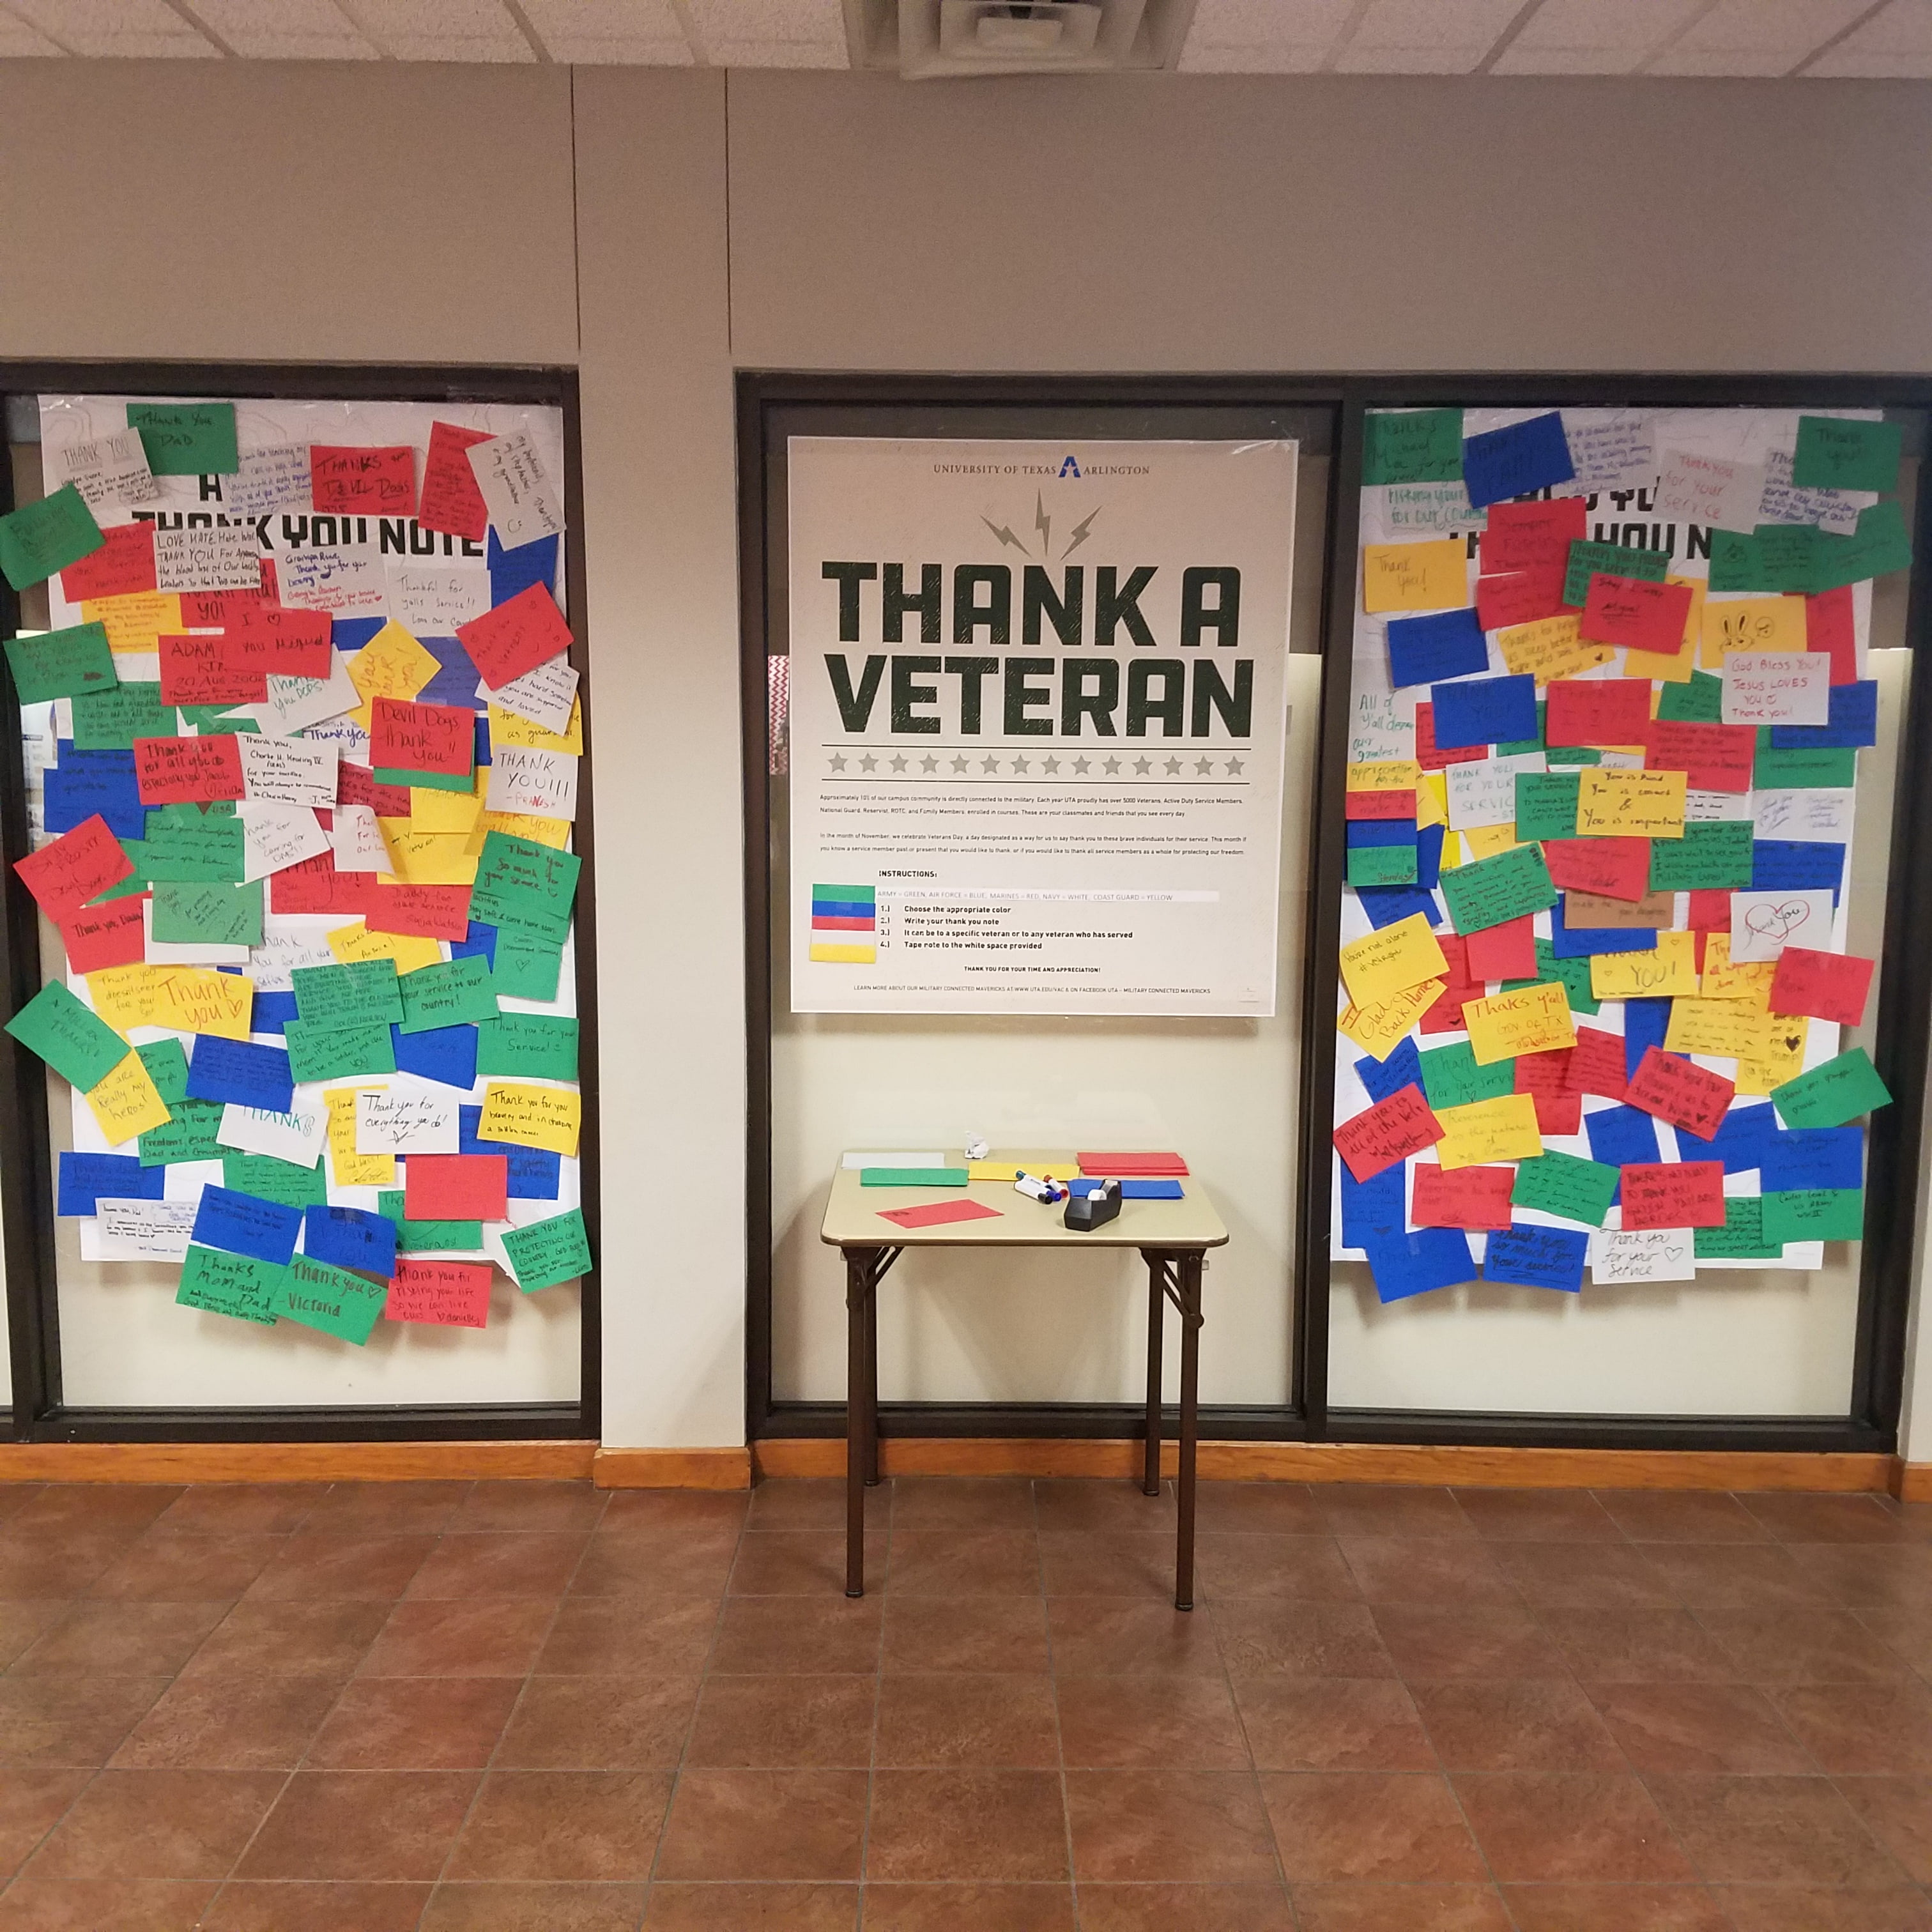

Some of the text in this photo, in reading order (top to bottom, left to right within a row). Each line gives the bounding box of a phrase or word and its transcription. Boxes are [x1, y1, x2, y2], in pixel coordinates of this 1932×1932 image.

[61, 437, 131, 466] THANK YOU
[933, 464, 1000, 474] UNIVERSITY
[1004, 466, 1018, 474] OF
[1022, 466, 1056, 474] TEXAS
[1084, 466, 1149, 475] ARLINGTON
[157, 532, 183, 549] LOVE
[190, 548, 233, 562] YOU For
[1374, 553, 1410, 572] Thank
[399, 576, 437, 592] Thankful
[822, 562, 1241, 647] THANK A
[171, 643, 215, 657] ADAM
[1760, 659, 1790, 670] Bless
[1771, 677, 1808, 688] LOVES
[824, 654, 1254, 737] VETERAN
[1360, 695, 1376, 709] All
[381, 702, 418, 722] Devil
[245, 735, 270, 746] Thank
[500, 753, 555, 770] THANK
[1483, 780, 1514, 789] YOUR
[1631, 817, 1683, 829] important
[505, 845, 540, 857] Thank
[158, 976, 234, 1006] Thank
[185, 1004, 222, 1030] you
[524, 1023, 555, 1036] you for
[363, 1094, 434, 1117] Thank you for
[491, 1090, 553, 1108] Thank you for
[365, 1116, 412, 1131] everything
[519, 1112, 532, 1121] and
[508, 1222, 558, 1245] THANK YOU
[512, 1236, 564, 1257] PROTECTING
[1602, 1248, 1660, 1264] for your
[292, 1261, 364, 1297] Thank you
[438, 1270, 454, 1283] you
[240, 1293, 271, 1311] Dad
